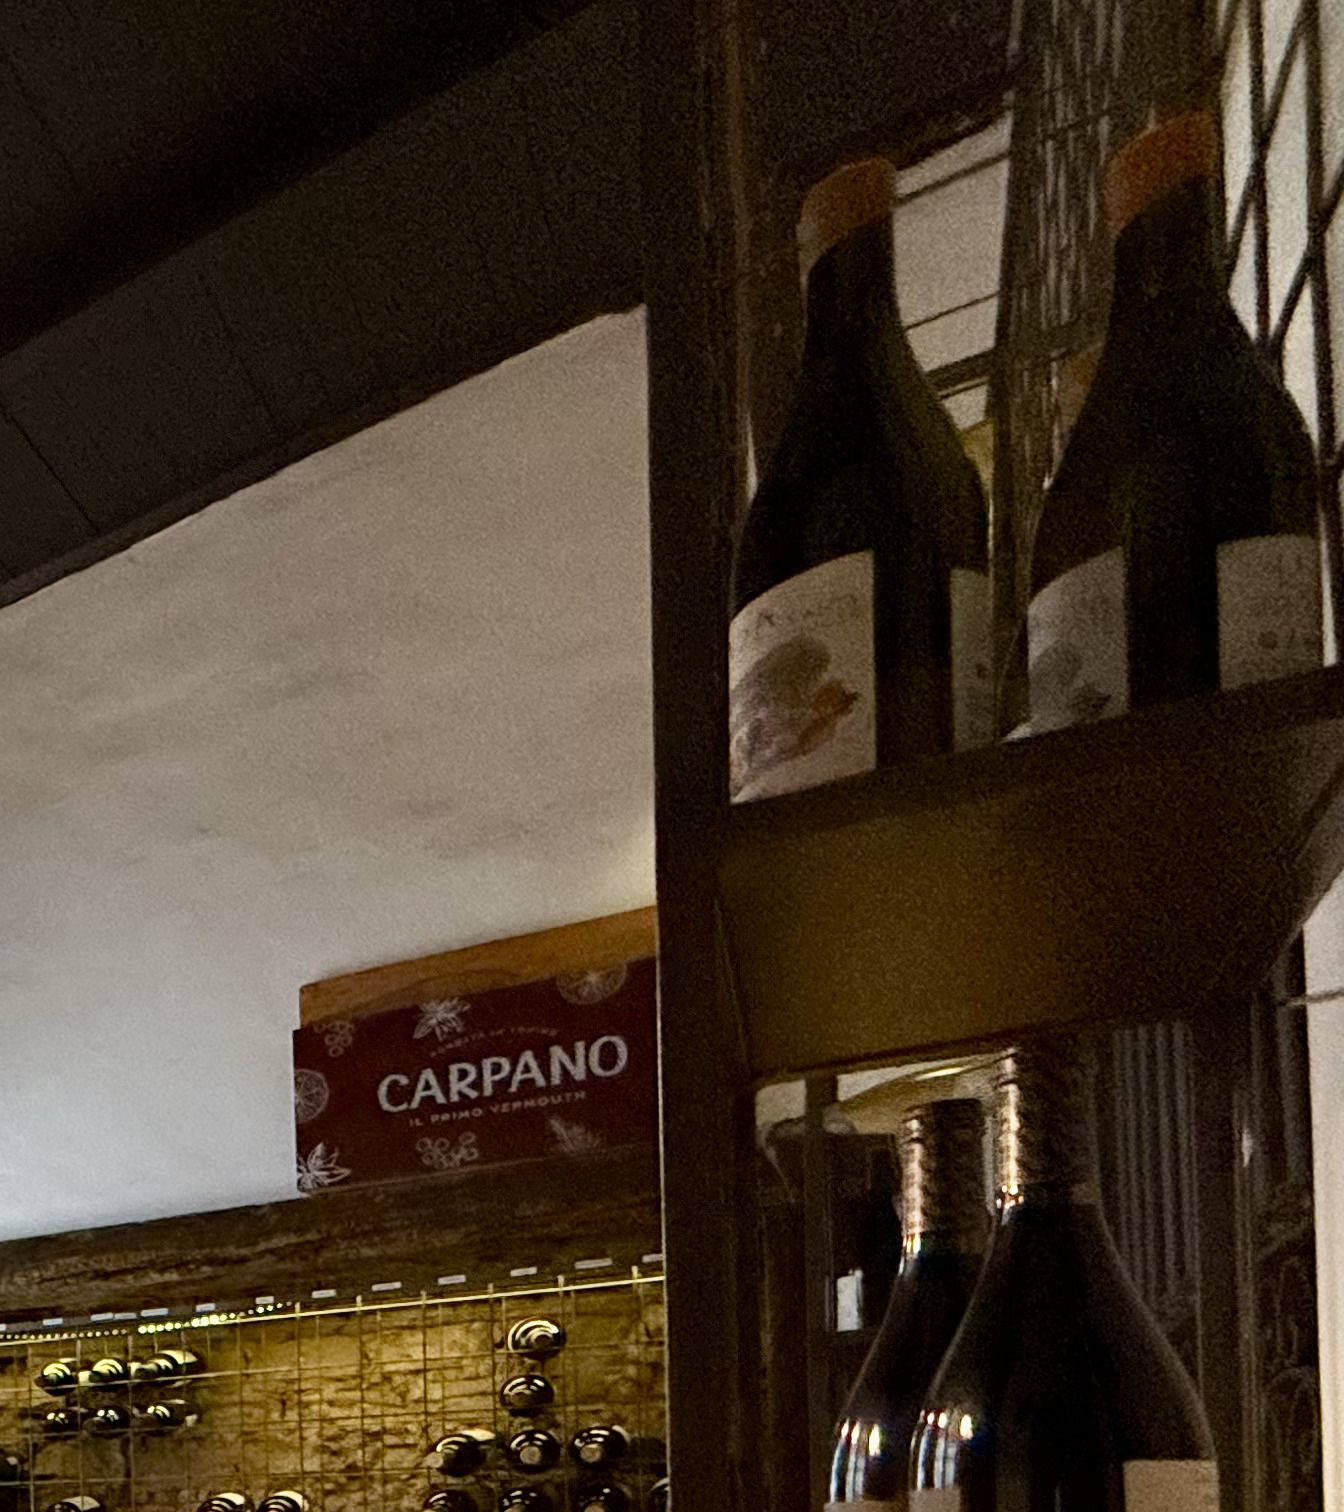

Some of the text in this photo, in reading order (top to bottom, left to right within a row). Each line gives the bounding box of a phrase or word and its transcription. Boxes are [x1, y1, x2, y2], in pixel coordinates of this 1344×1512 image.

[376, 1034, 629, 1113] CARPANO
[408, 1090, 587, 1127] IL PRIMO VERMOUTH
